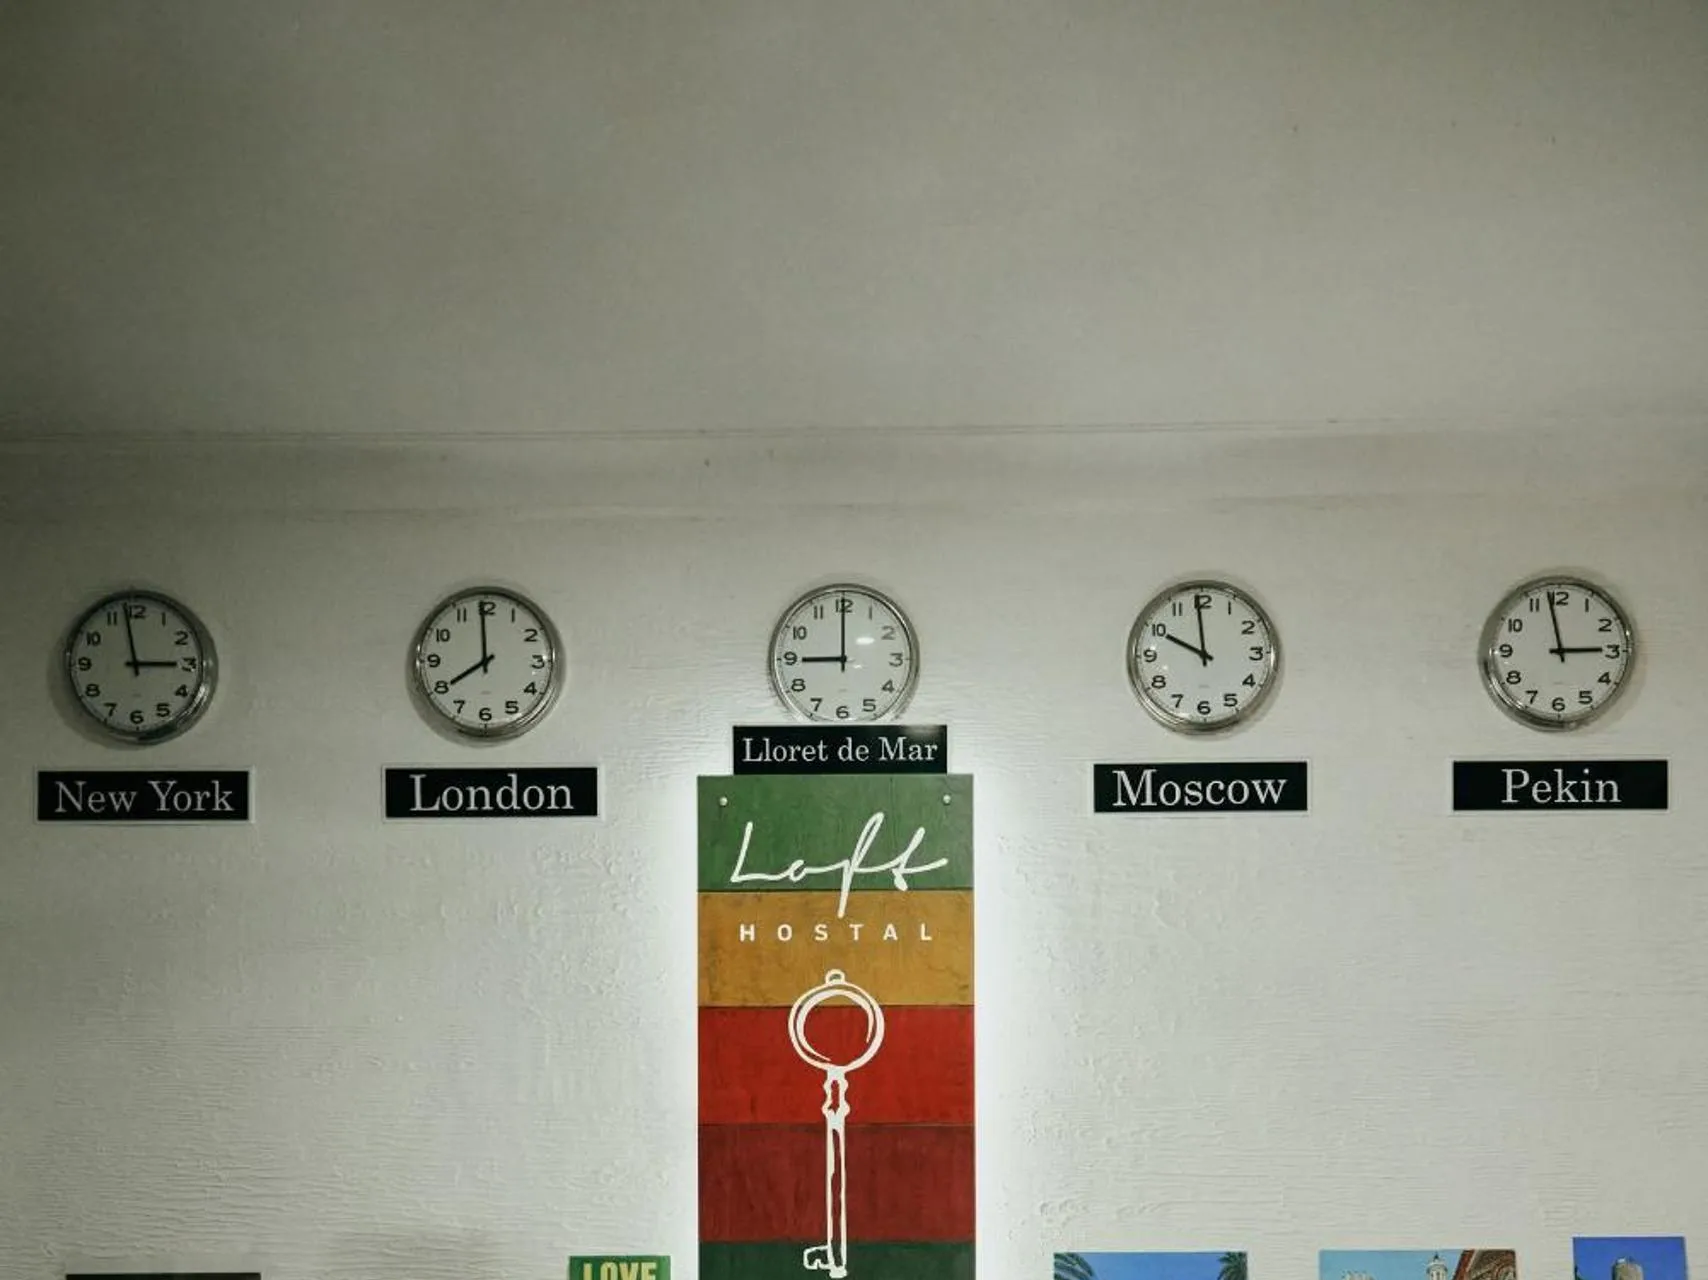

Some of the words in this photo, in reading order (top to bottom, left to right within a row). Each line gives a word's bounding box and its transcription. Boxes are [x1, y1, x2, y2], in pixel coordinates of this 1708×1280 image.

[813, 604, 824, 620] 11
[1171, 601, 1183, 616] 11
[1529, 598, 1540, 612] 11
[107, 612, 117, 625] 11
[456, 608, 467, 622] 11
[1151, 623, 1166, 637] 10
[1241, 620, 1255, 635] 2
[1507, 618, 1523, 632] 10
[1597, 618, 1612, 632] 2
[86, 632, 100, 646] 10
[174, 631, 189, 645] 2
[436, 628, 450, 642] 10
[523, 628, 538, 642] 2
[792, 625, 808, 640] 10
[881, 625, 896, 640] 2
[1143, 649, 1157, 663] 9
[1248, 646, 1264, 661] 3
[1499, 644, 1514, 658] 9
[1605, 644, 1620, 659] 3
[78, 657, 92, 671] 9
[180, 657, 197, 672] 3
[427, 654, 441, 668] 9
[531, 655, 545, 669] 3
[783, 651, 798, 666] 9
[888, 652, 903, 667] 3
[1151, 675, 1166, 689] 8
[1242, 673, 1256, 688] 4
[1506, 670, 1521, 685] 8
[1597, 672, 1611, 685] 4
[85, 684, 100, 697] 8
[175, 684, 188, 698] 4
[434, 680, 449, 694] 8
[523, 681, 538, 695] 4
[790, 678, 806, 692] 8
[881, 679, 895, 693] 4
[1170, 693, 1184, 708] 7
[1223, 693, 1238, 707] 5
[1525, 690, 1539, 704] 7
[1578, 690, 1593, 704] 5
[104, 703, 118, 717] 7
[156, 703, 171, 718] 5
[453, 700, 465, 714] 7
[504, 700, 519, 714] 5
[810, 698, 823, 712] 7
[862, 698, 876, 712] 5
[1197, 701, 1211, 715] 6
[1551, 697, 1566, 712] 6
[129, 710, 144, 724] 6
[479, 707, 493, 721] 6
[835, 705, 849, 719] 6
[742, 737, 828, 762] Lloret
[837, 737, 870, 762] de
[878, 736, 938, 761] Mar
[409, 773, 574, 811] London
[1112, 769, 1288, 806] Moscow
[1501, 768, 1622, 804] Pekin
[54, 780, 138, 813] New
[147, 780, 235, 812] York
[730, 812, 949, 918] Loft
[739, 924, 932, 942] HOSTAL
